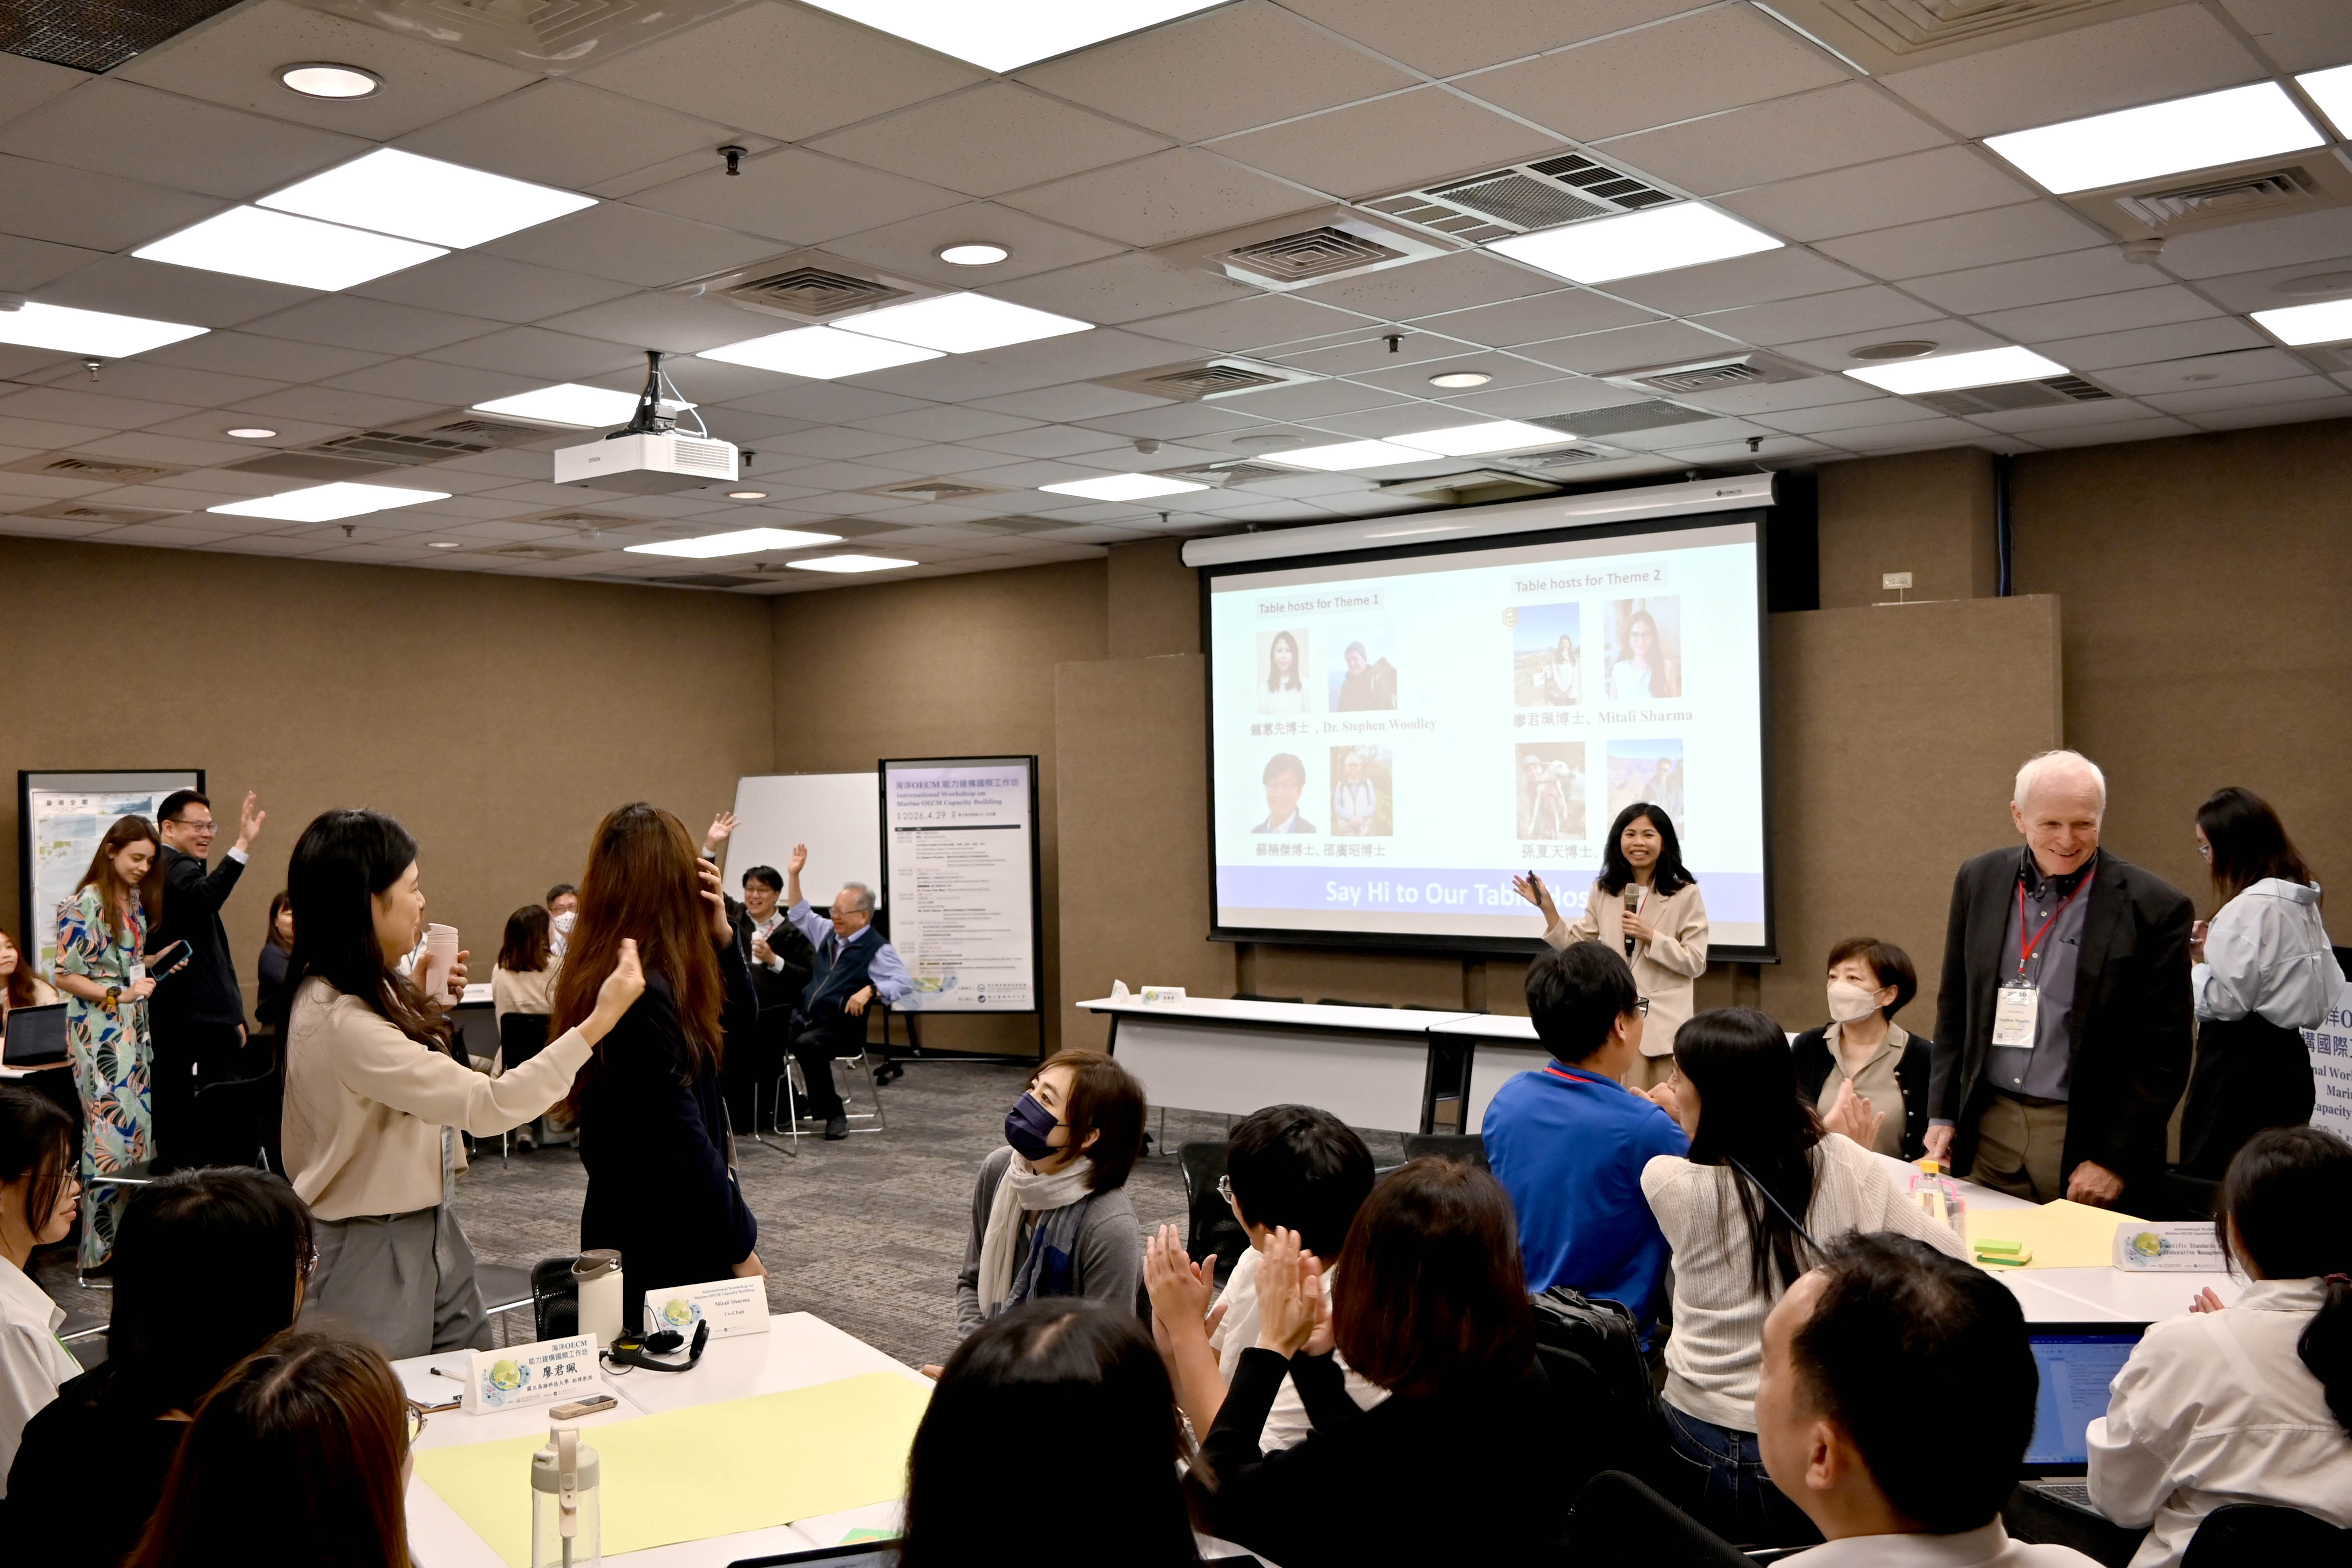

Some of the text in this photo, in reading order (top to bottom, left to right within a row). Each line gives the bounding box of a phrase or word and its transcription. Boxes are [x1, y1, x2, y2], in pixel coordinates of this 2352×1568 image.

[1515, 569, 1661, 593] Table hosts for Theme 2
[1259, 595, 1379, 614] Table hosts for Theme 1
[1598, 710, 1636, 723] Mitali
[1640, 709, 1693, 722] Sharma
[1323, 721, 1339, 733] Dr.
[1342, 719, 1385, 734] Stephen
[1389, 717, 1436, 731] Woodley
[1326, 881, 1589, 908] Say Hi to Our Tabl Hos
[2302, 1031, 2352, 1059] 構國際
[2326, 1084, 2352, 1099] Mari
[2315, 1103, 2351, 1120] apacity
[552, 1340, 587, 1352] 海洋OECM
[529, 1348, 588, 1365] 能力建構國際工作坊
